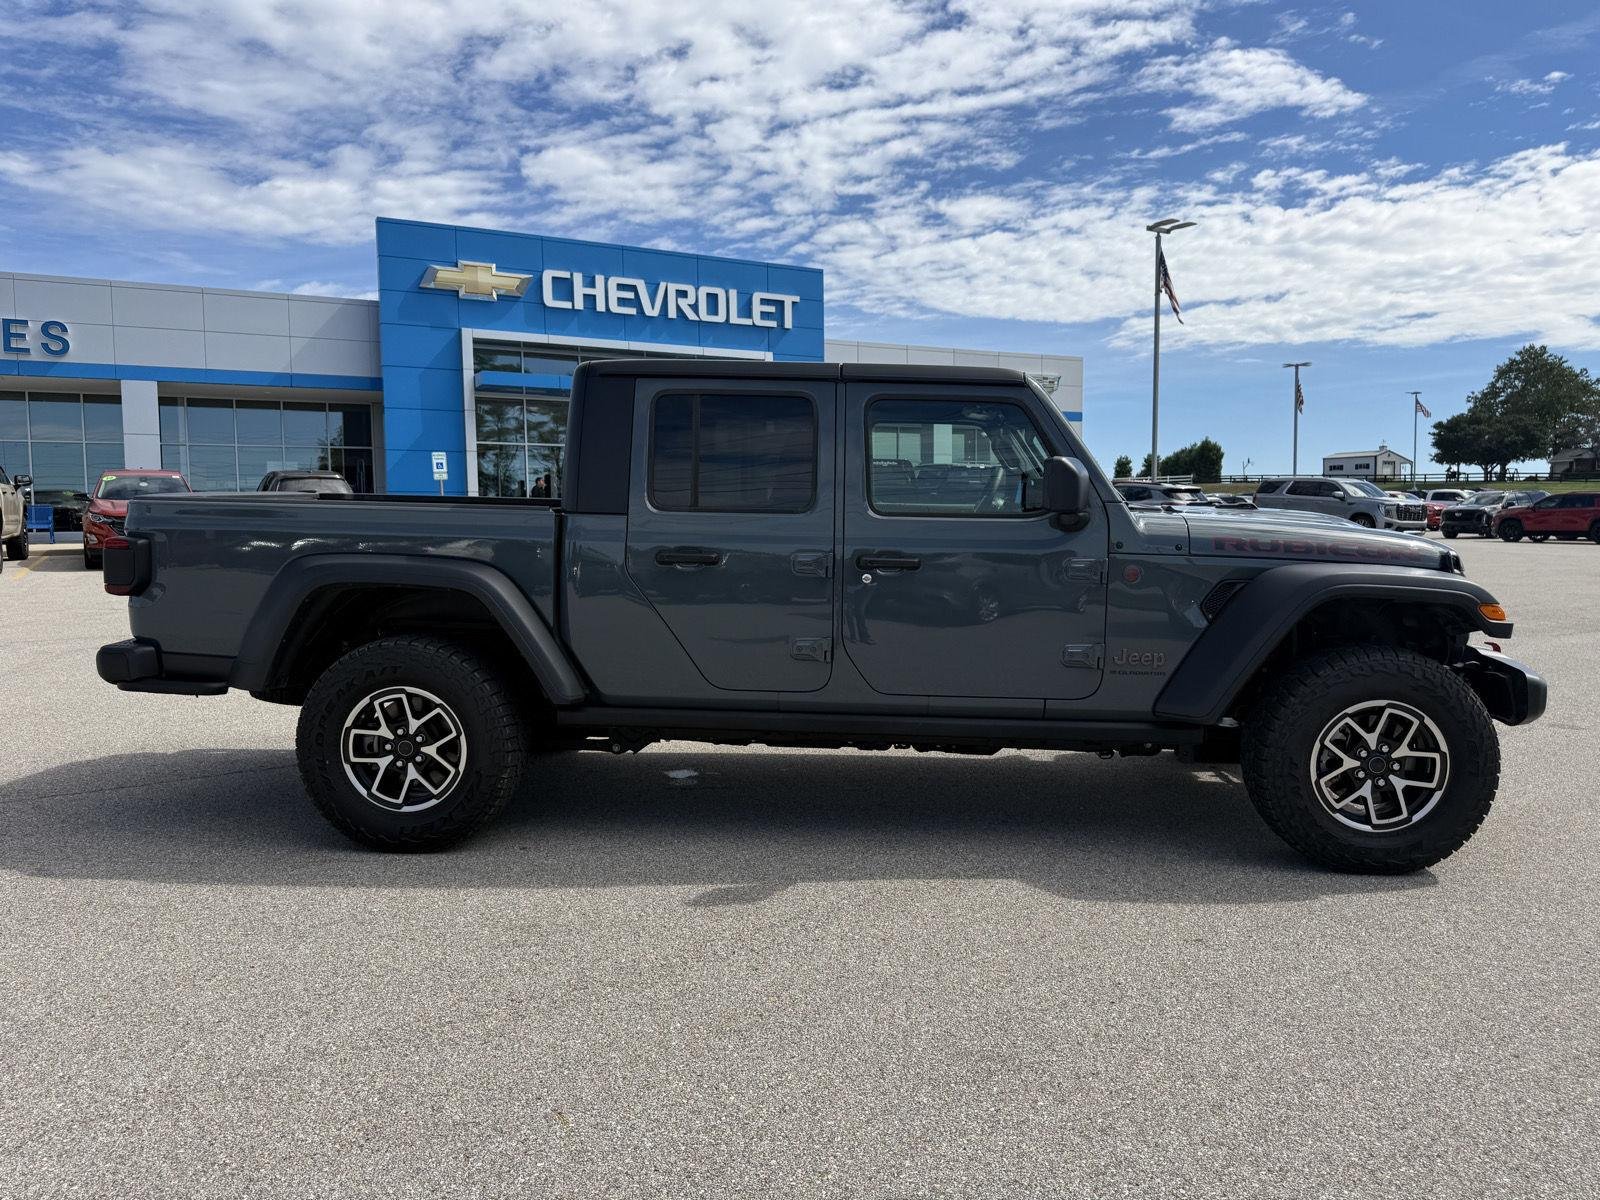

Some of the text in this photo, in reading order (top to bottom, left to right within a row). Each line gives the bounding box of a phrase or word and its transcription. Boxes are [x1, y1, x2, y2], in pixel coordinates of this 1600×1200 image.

[541, 269, 800, 329] CHEVROLET
[2, 318, 70, 355] ES
[1213, 536, 1423, 562] RUBICON
[1112, 648, 1166, 668] Jeep
